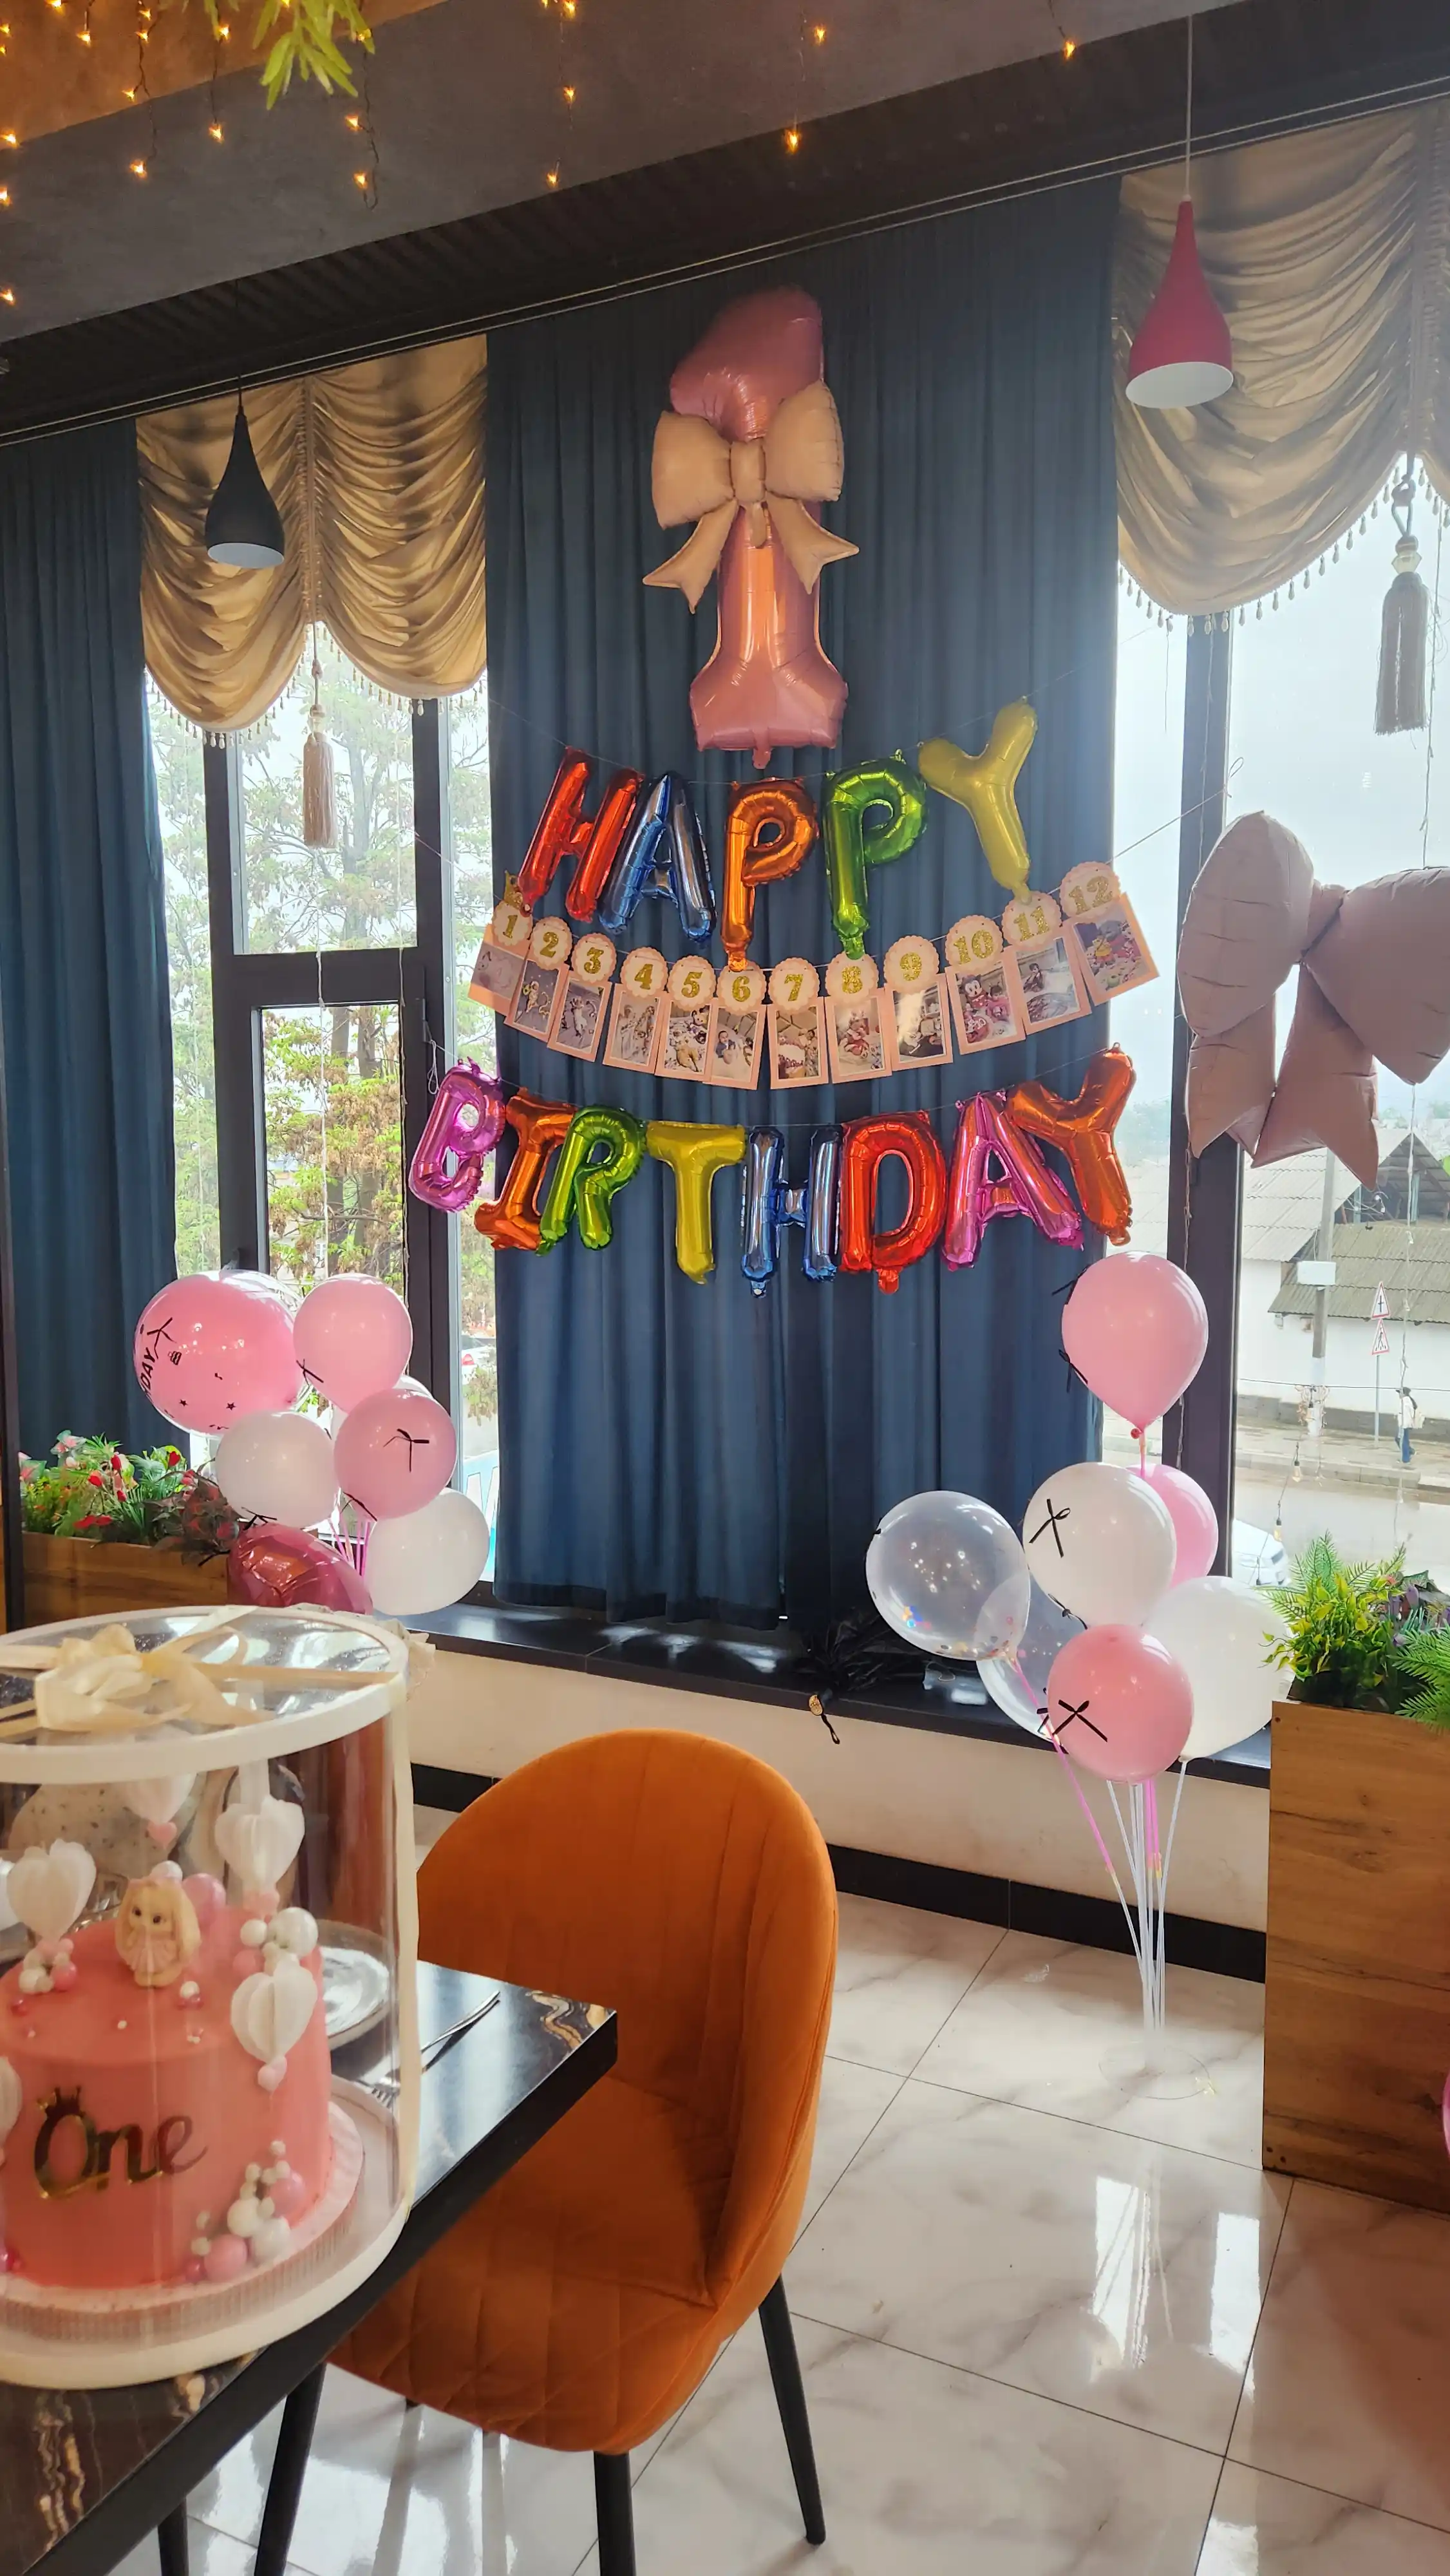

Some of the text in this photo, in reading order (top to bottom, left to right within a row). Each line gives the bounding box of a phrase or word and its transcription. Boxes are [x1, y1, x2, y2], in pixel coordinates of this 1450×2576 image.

[515, 696, 1039, 971] HAPPY
[502, 875, 1113, 1002] 1 2 3 4 5 6 7 8 9 10 11 12
[409, 1042, 1136, 1298] BIRTHDAY
[33, 2085, 209, 2199] One
